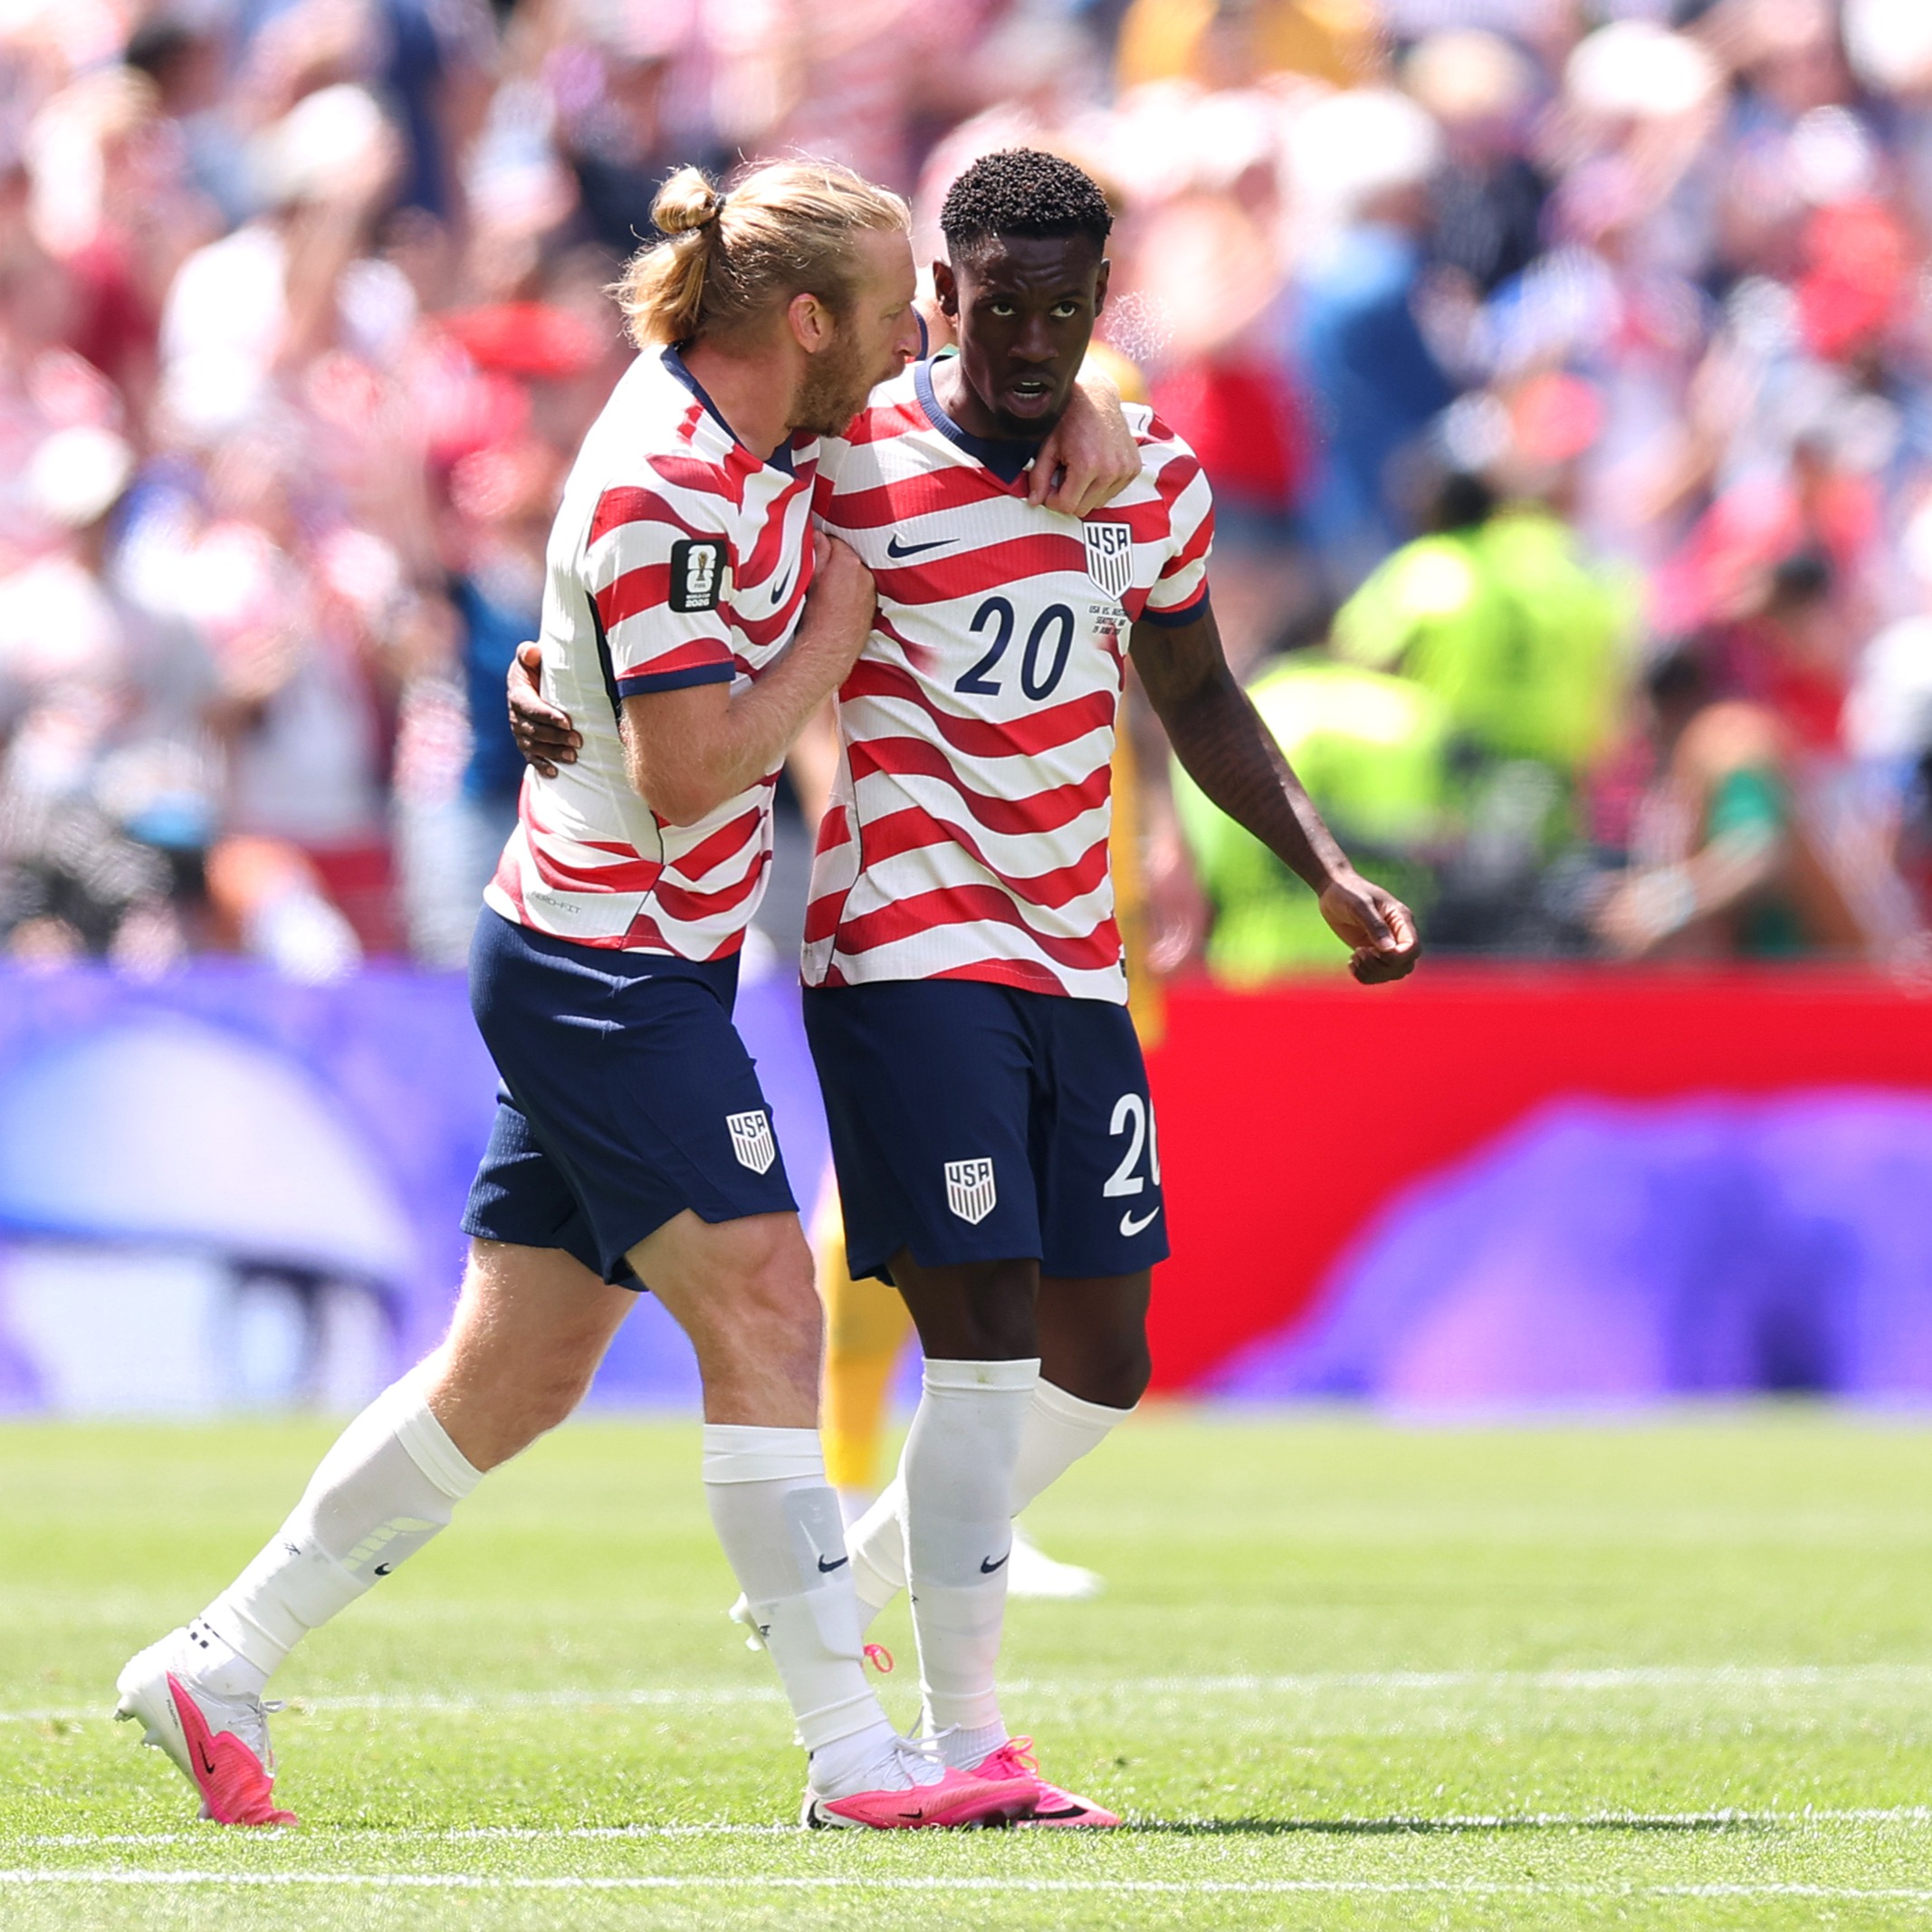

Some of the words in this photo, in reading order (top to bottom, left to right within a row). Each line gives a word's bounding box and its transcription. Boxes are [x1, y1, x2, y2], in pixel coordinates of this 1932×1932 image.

[1086, 526, 1128, 555] USA
[685, 598, 710, 607] 2026
[954, 596, 1075, 701] 20
[731, 1114, 766, 1138] USA
[948, 1162, 990, 1188] USA
